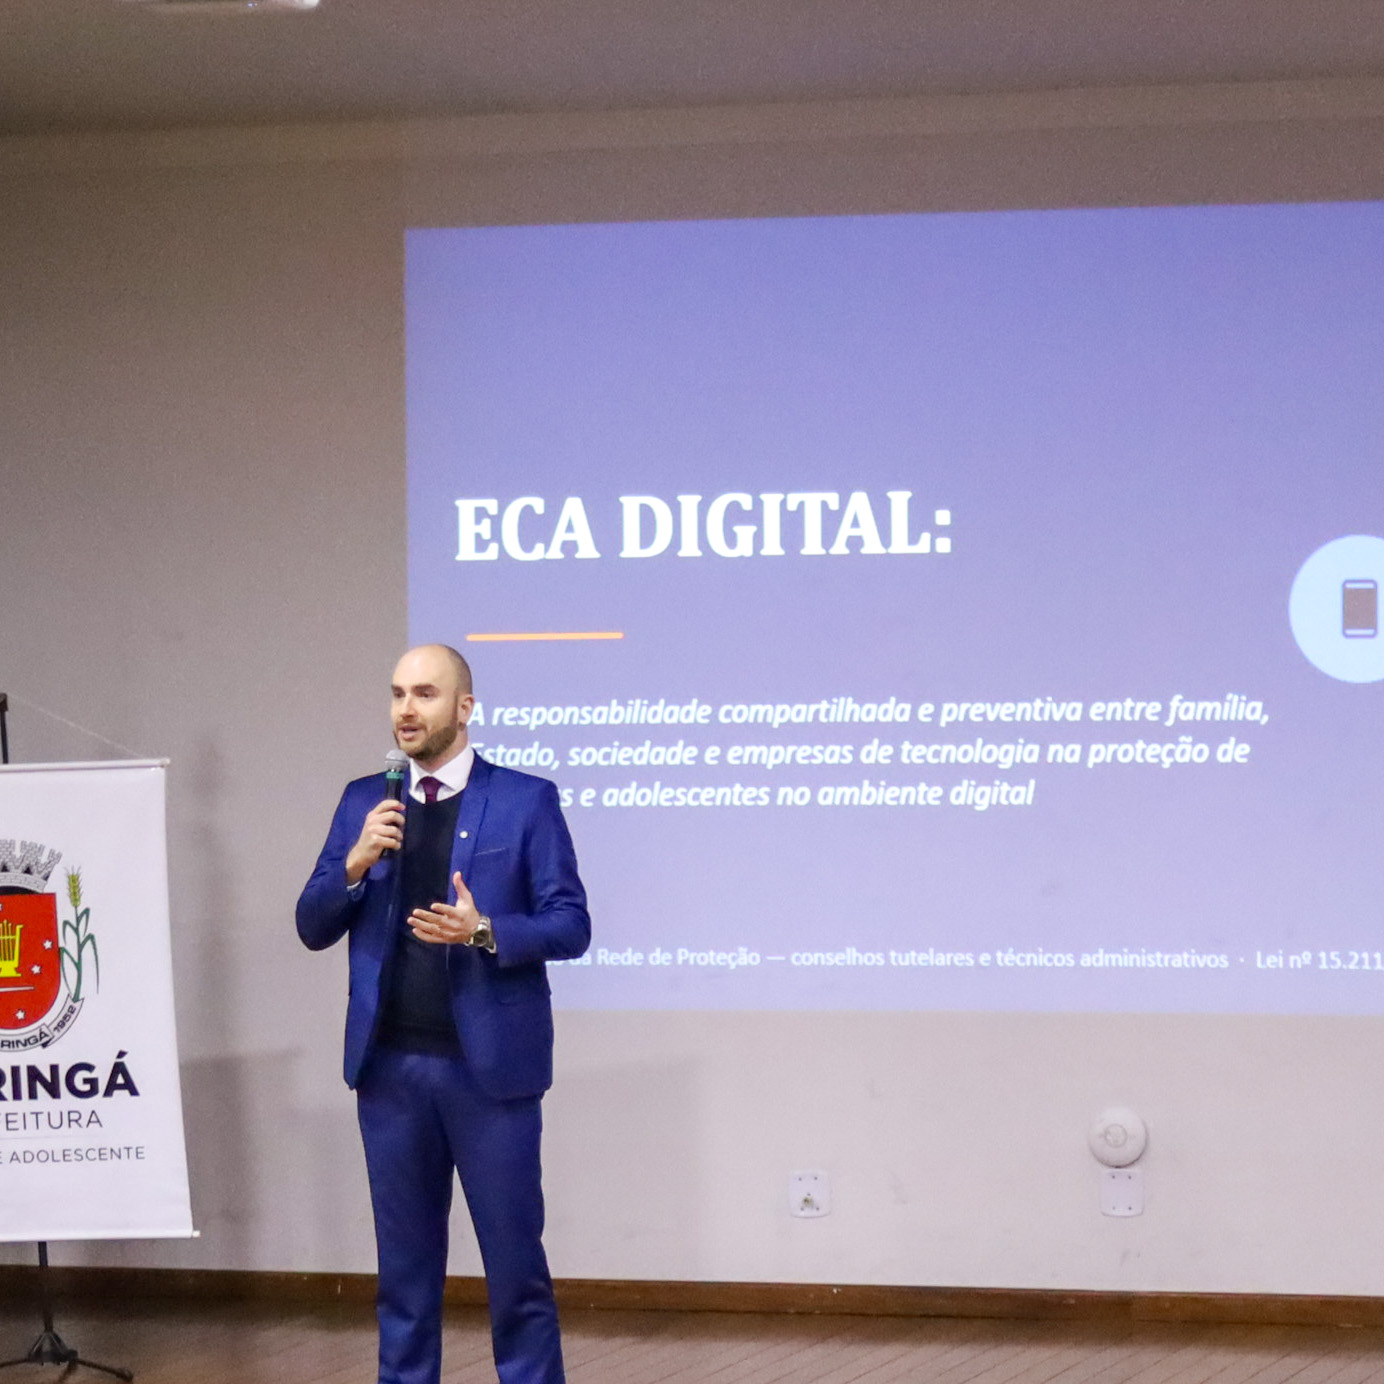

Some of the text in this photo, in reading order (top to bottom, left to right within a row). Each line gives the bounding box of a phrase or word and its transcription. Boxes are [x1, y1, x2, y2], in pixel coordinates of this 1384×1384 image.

[454, 490, 952, 562] ECA DIGITAL:
[468, 692, 1269, 731] A responsabilidade compartilhada e preventiva entre família,
[567, 739, 699, 767] sociedade
[703, 745, 721, 765] e
[726, 744, 854, 770] empresas
[859, 737, 894, 765] de
[900, 737, 1040, 769] tecnologia
[1046, 743, 1082, 764] na
[1087, 735, 1210, 769] proteção
[1215, 736, 1251, 763] de
[579, 787, 597, 808] e
[602, 780, 771, 807] adolescentes
[776, 786, 812, 806] no
[816, 779, 944, 806] ambiente
[949, 778, 1036, 811] digital
[596, 946, 645, 966] Rede
[648, 947, 673, 966] de
[676, 946, 761, 970] Proteção
[790, 946, 886, 966] conselhos
[889, 947, 975, 967] tutelares
[978, 952, 992, 967] e
[995, 947, 1076, 967] técnicos
[1079, 948, 1230, 969] administrativos
[1256, 949, 1284, 969] Lei
[53, 1004, 77, 1034] 1952
[9, 1146, 145, 1164] ADOLESCENTE
